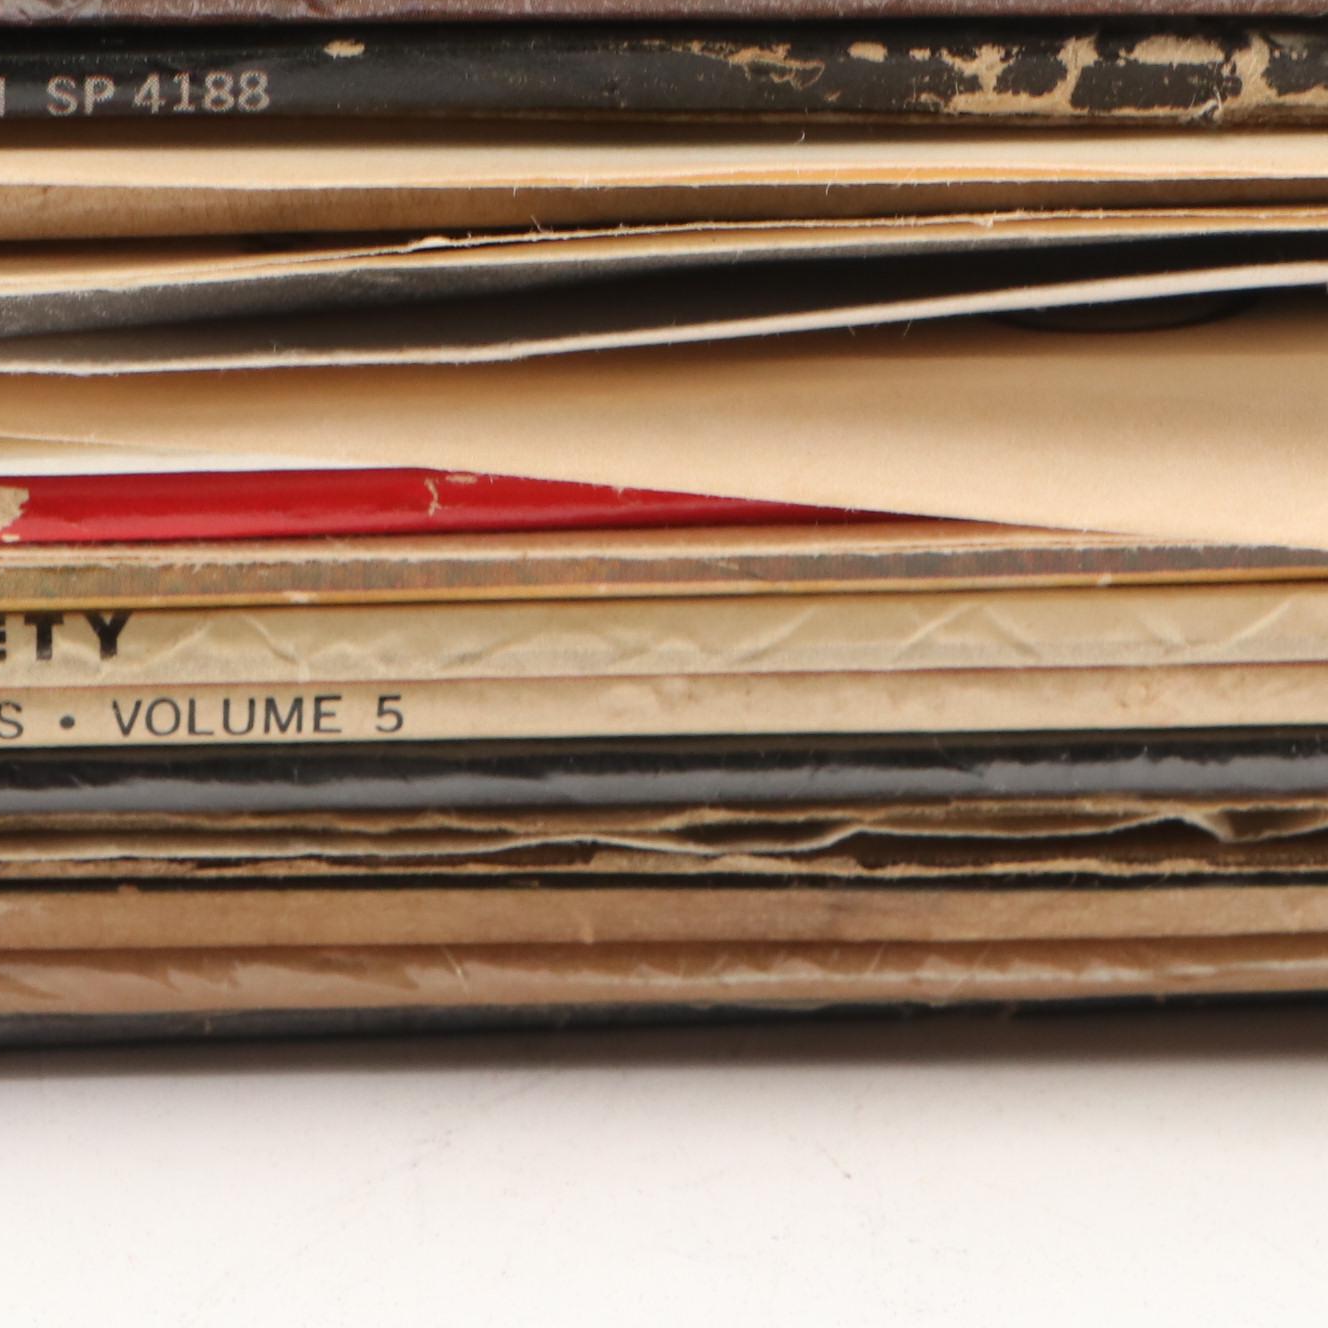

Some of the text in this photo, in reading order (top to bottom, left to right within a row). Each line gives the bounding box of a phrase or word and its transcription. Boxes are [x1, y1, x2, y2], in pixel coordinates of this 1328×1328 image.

[45, 76, 115, 116] SP
[134, 72, 271, 114] 4188
[112, 694, 343, 739] VOLUME
[375, 694, 405, 735] 5
